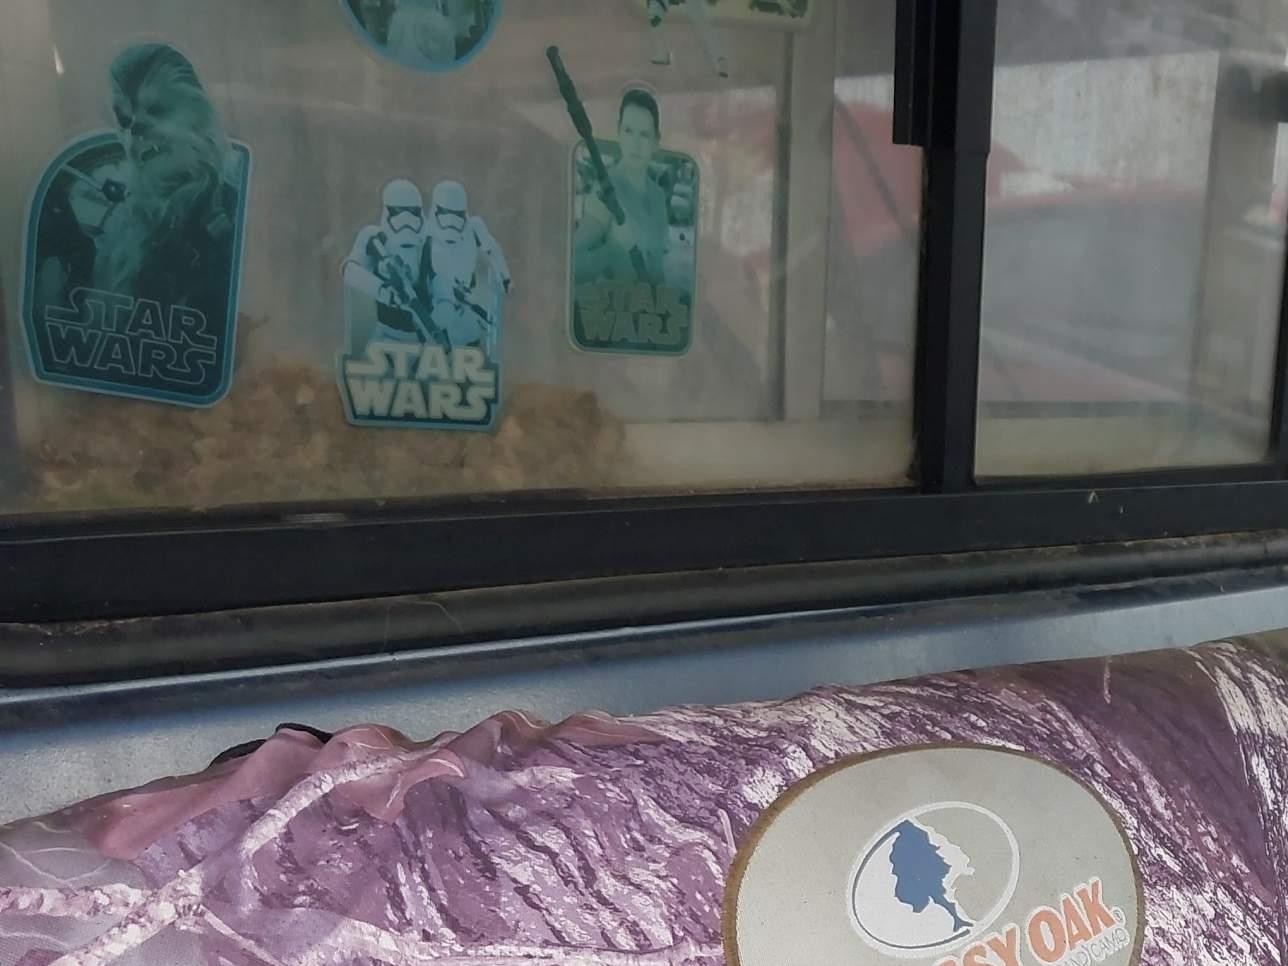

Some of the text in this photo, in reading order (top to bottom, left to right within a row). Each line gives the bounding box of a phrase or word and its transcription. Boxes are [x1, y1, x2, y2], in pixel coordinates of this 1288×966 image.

[45, 286, 217, 350] STAR
[578, 308, 688, 345] WARS
[46, 321, 217, 385] WARS
[345, 343, 495, 383] STAR
[347, 378, 495, 420] WARS
